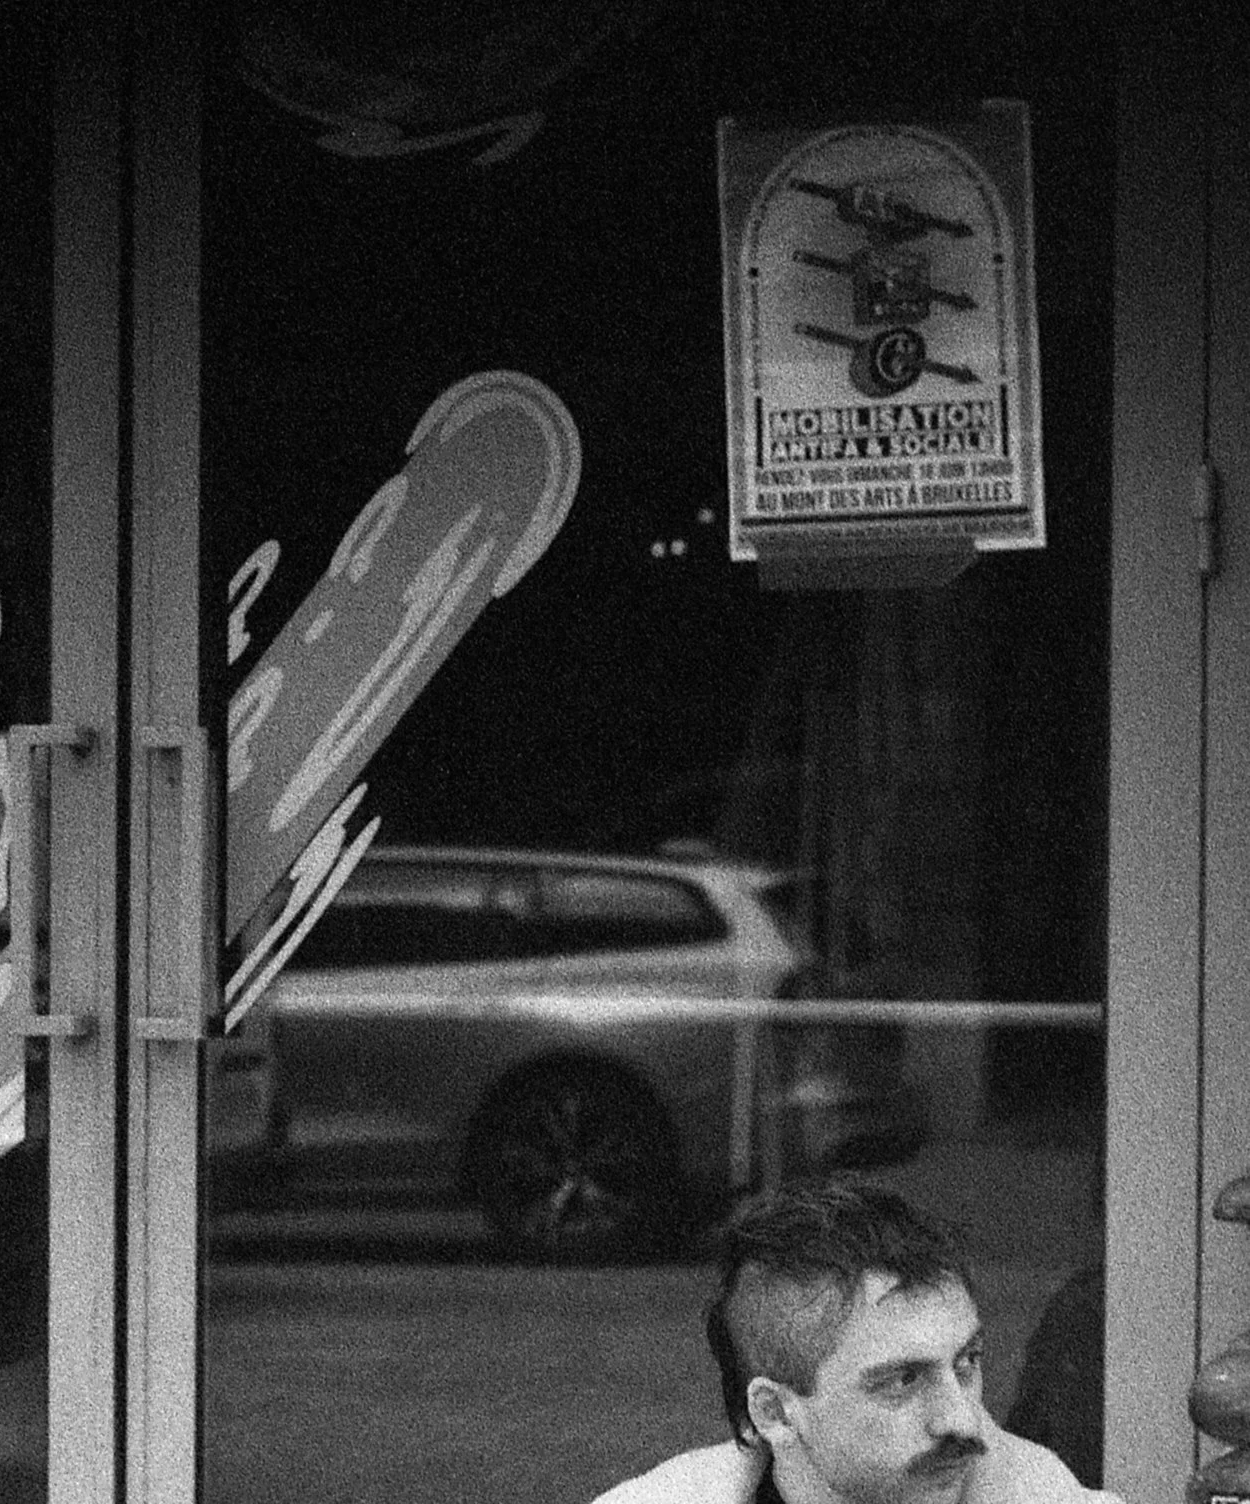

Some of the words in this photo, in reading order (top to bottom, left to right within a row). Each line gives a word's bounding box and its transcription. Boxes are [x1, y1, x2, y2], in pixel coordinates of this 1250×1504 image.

[770, 402, 994, 435] MOBILISATION
[771, 436, 857, 460] ANTIFA
[756, 491, 779, 510] AU
[781, 489, 823, 509] MONT
[828, 487, 860, 507] DES
[863, 484, 900, 507] ARTS
[921, 478, 1013, 504] BRUXELLES
